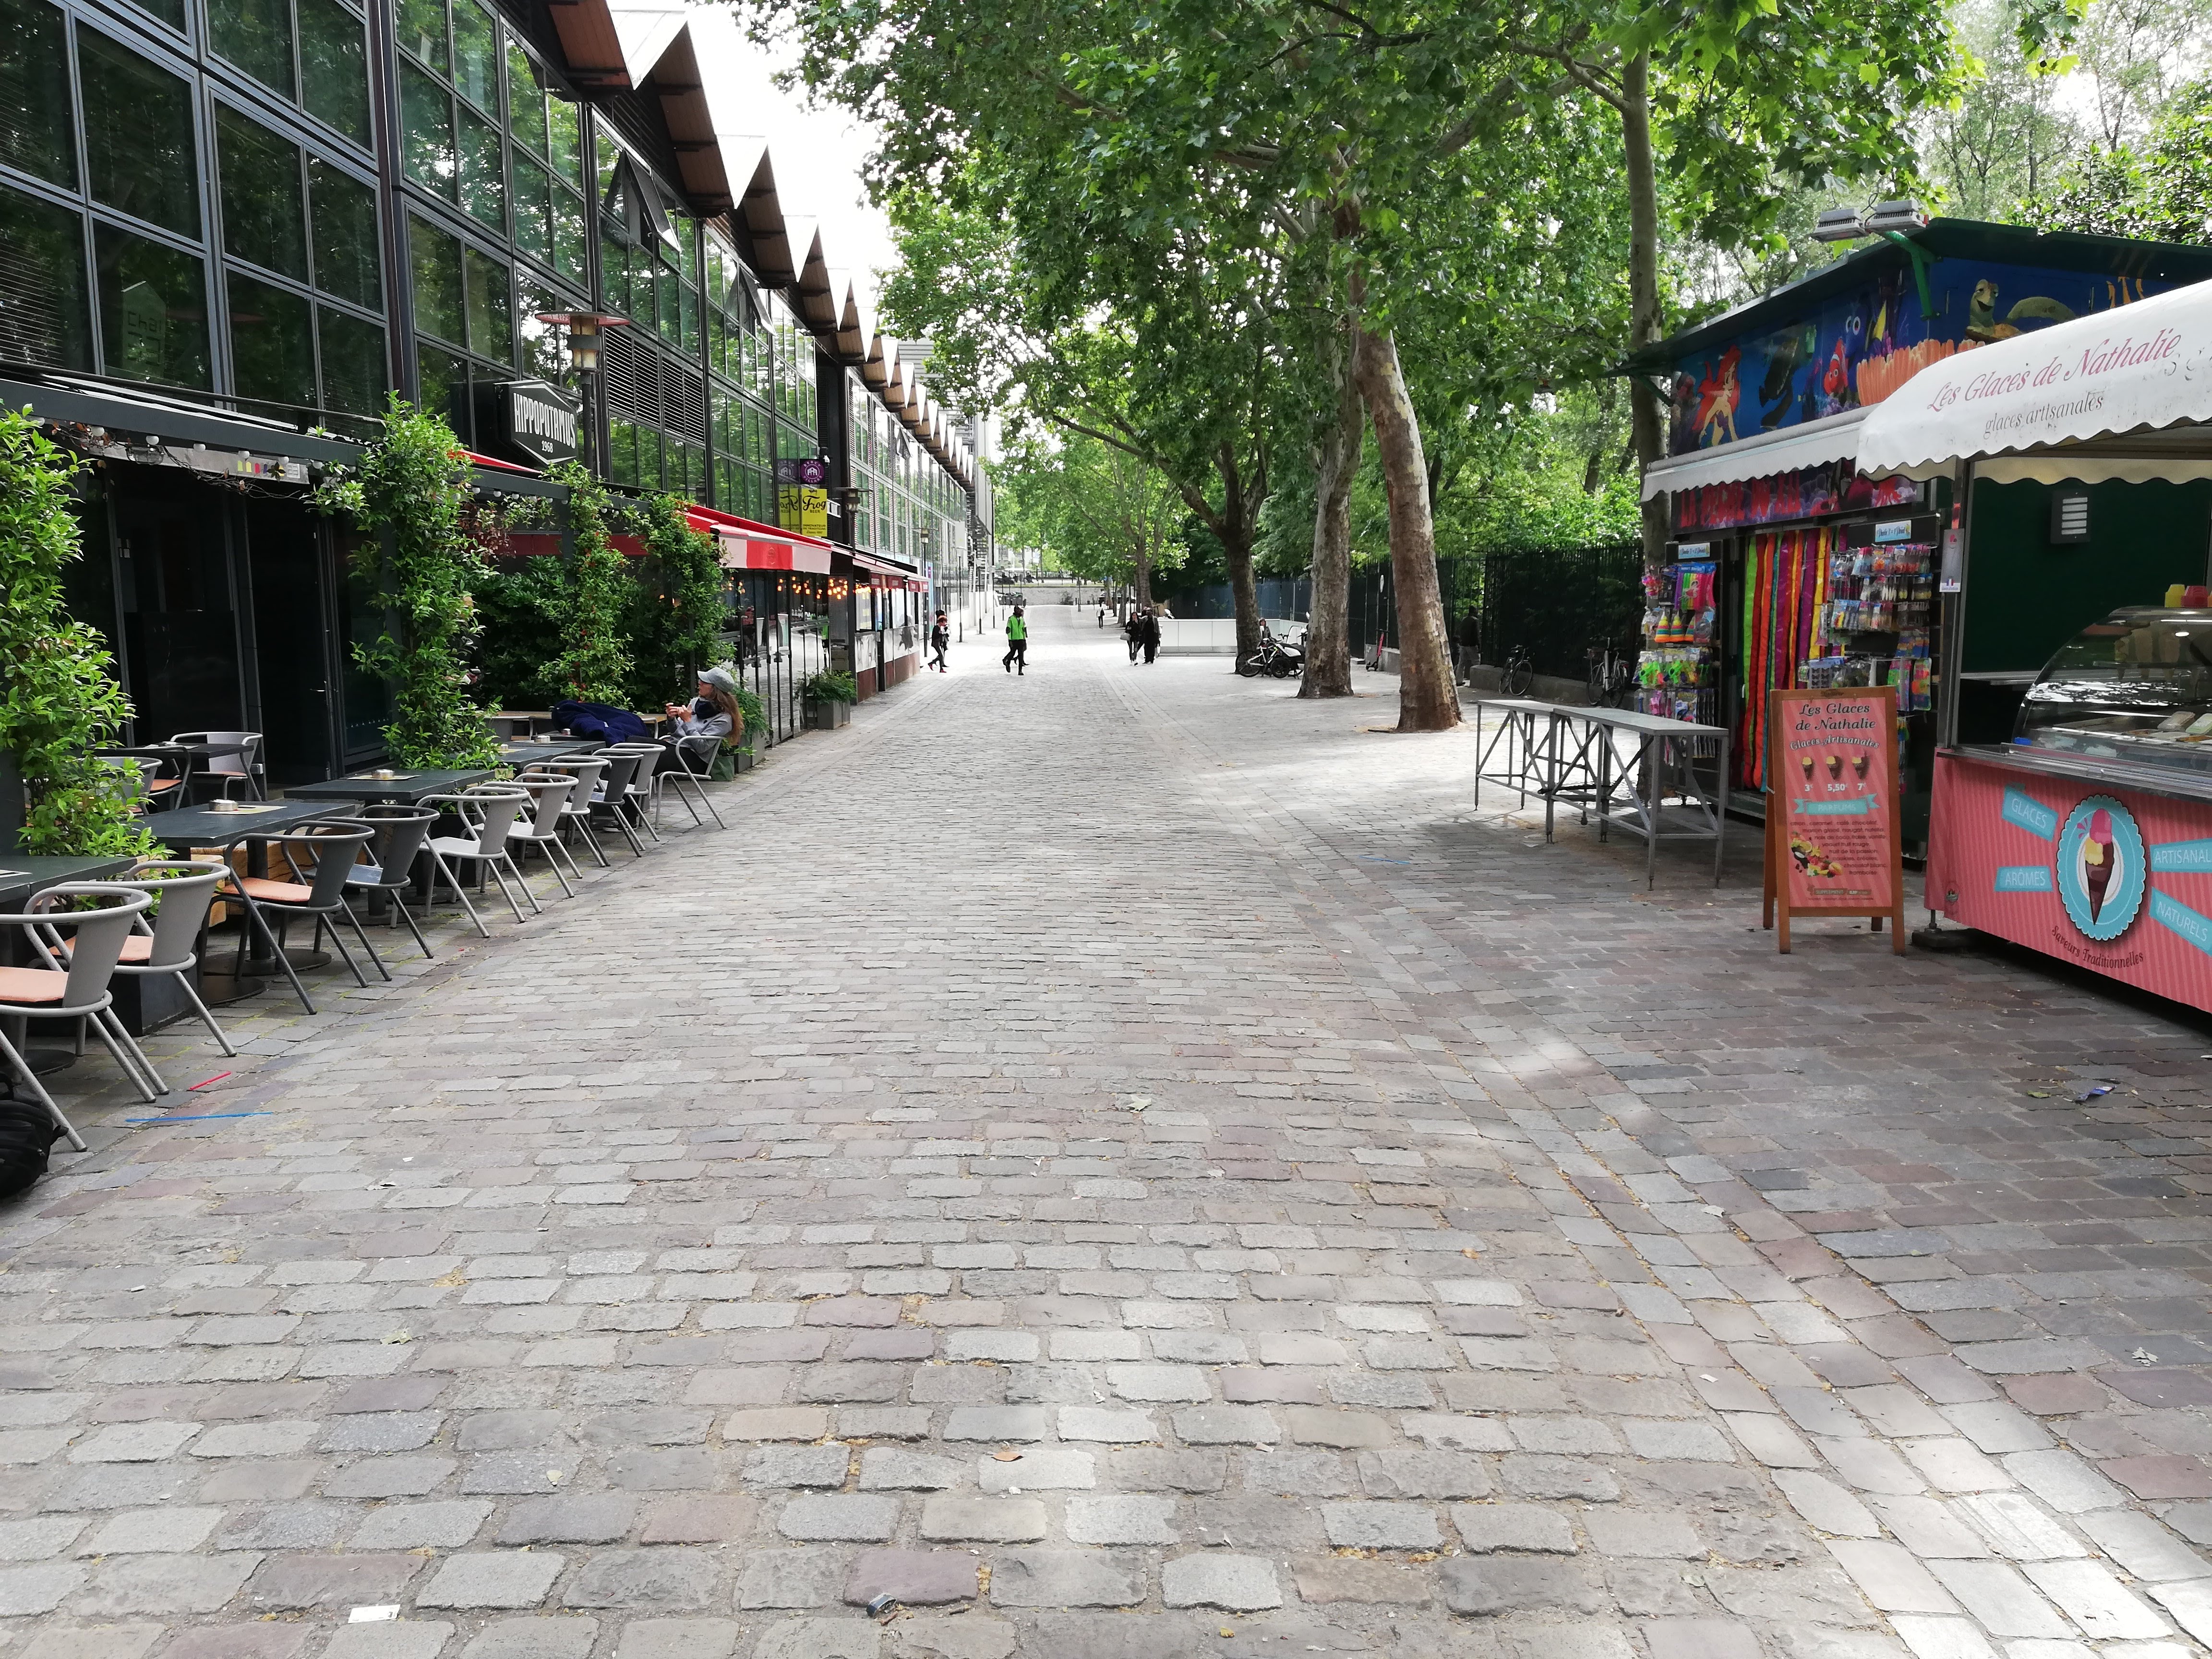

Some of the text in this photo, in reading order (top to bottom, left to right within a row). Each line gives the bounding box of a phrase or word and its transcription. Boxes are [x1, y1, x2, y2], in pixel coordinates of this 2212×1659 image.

[1927, 328, 2181, 412] Les Glaces de Nathalie
[513, 393, 576, 448] HIPPOPOTAMUS
[1983, 391, 2104, 439] glaces artisanales
[541, 440, 553, 453] 1968
[802, 495, 827, 511] Frog
[1799, 703, 1870, 716] Les Glaces
[1796, 717, 1876, 730] de Nathalie
[1790, 734, 1879, 751] Glaces Artisanales
[1818, 803, 1857, 812] PARFUMS
[2011, 798, 2047, 829] GLACES
[2005, 868, 2045, 886] ARÔMES
[2156, 901, 2208, 942] NATURELS
[2051, 926, 2144, 969] Saveurs Traditionnelles
